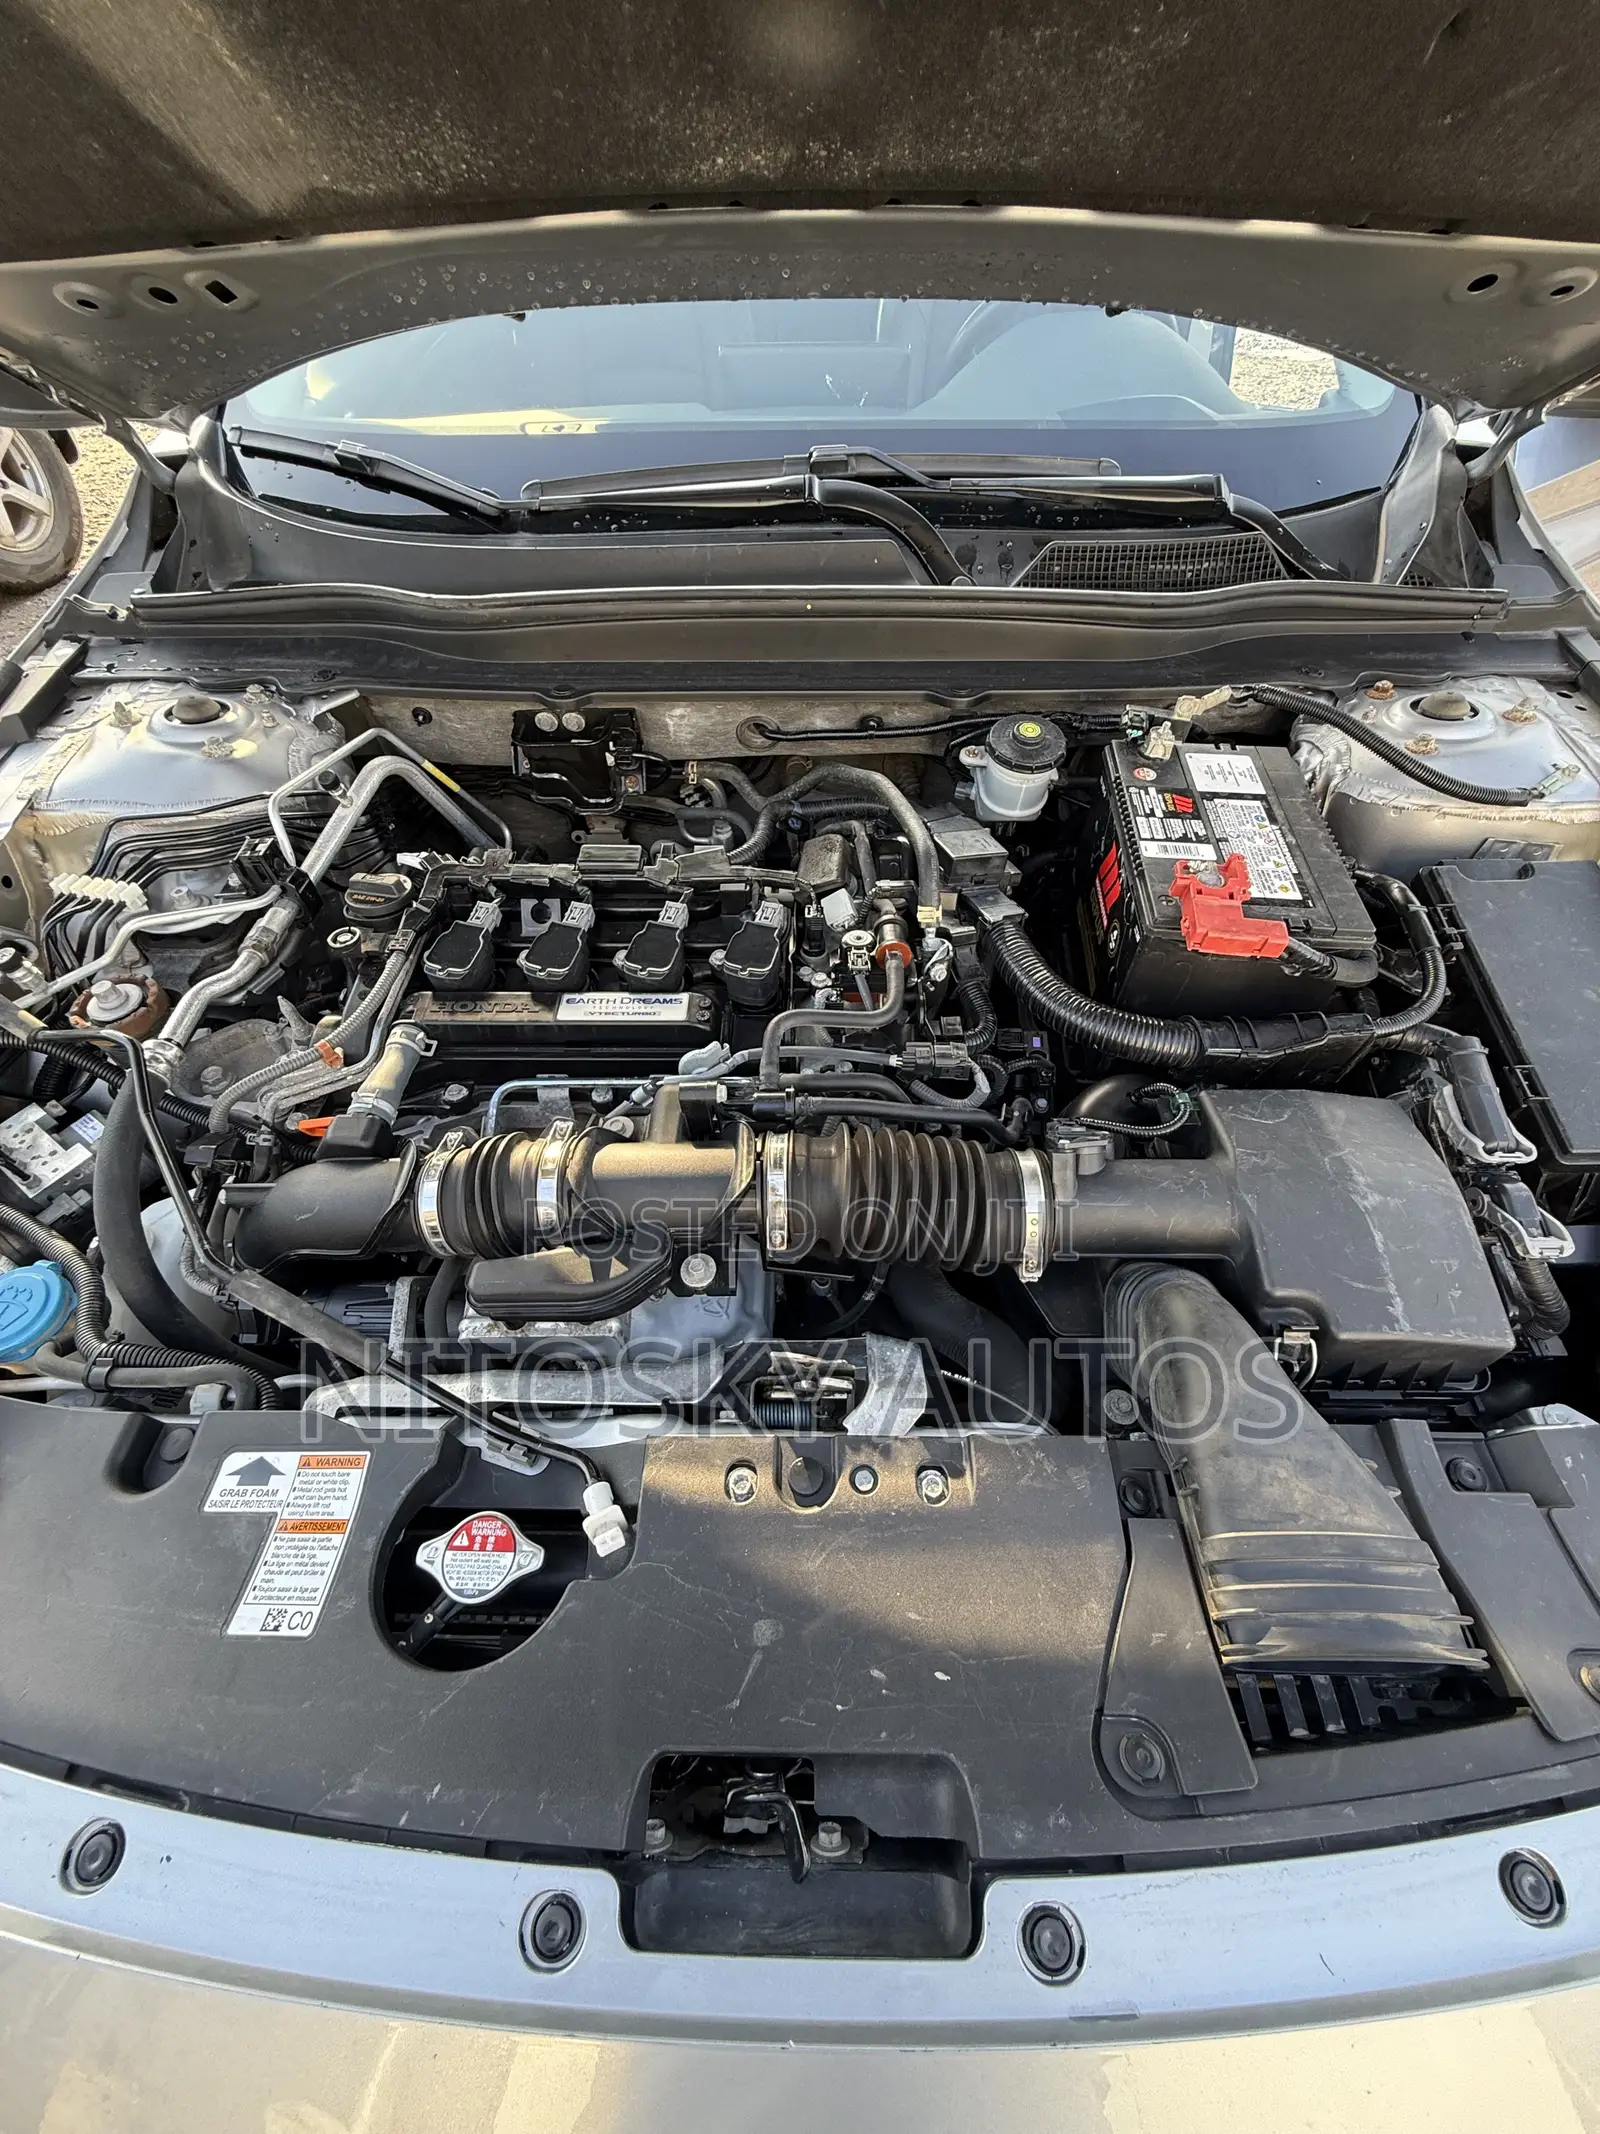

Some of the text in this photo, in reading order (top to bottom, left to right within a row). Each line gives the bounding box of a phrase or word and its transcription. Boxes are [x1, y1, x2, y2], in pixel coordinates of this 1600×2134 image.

[429, 1000, 540, 1013] HONDA
[316, 1458, 361, 1466] WARNING
[220, 1488, 280, 1498] GRAB FOAM
[208, 1500, 284, 1508] SAISIR LE PROTECTEUR
[290, 1522, 346, 1531] AVERTISSEMENT
[472, 1520, 502, 1528] DANGER
[472, 1528, 506, 1536] WARNUNG
